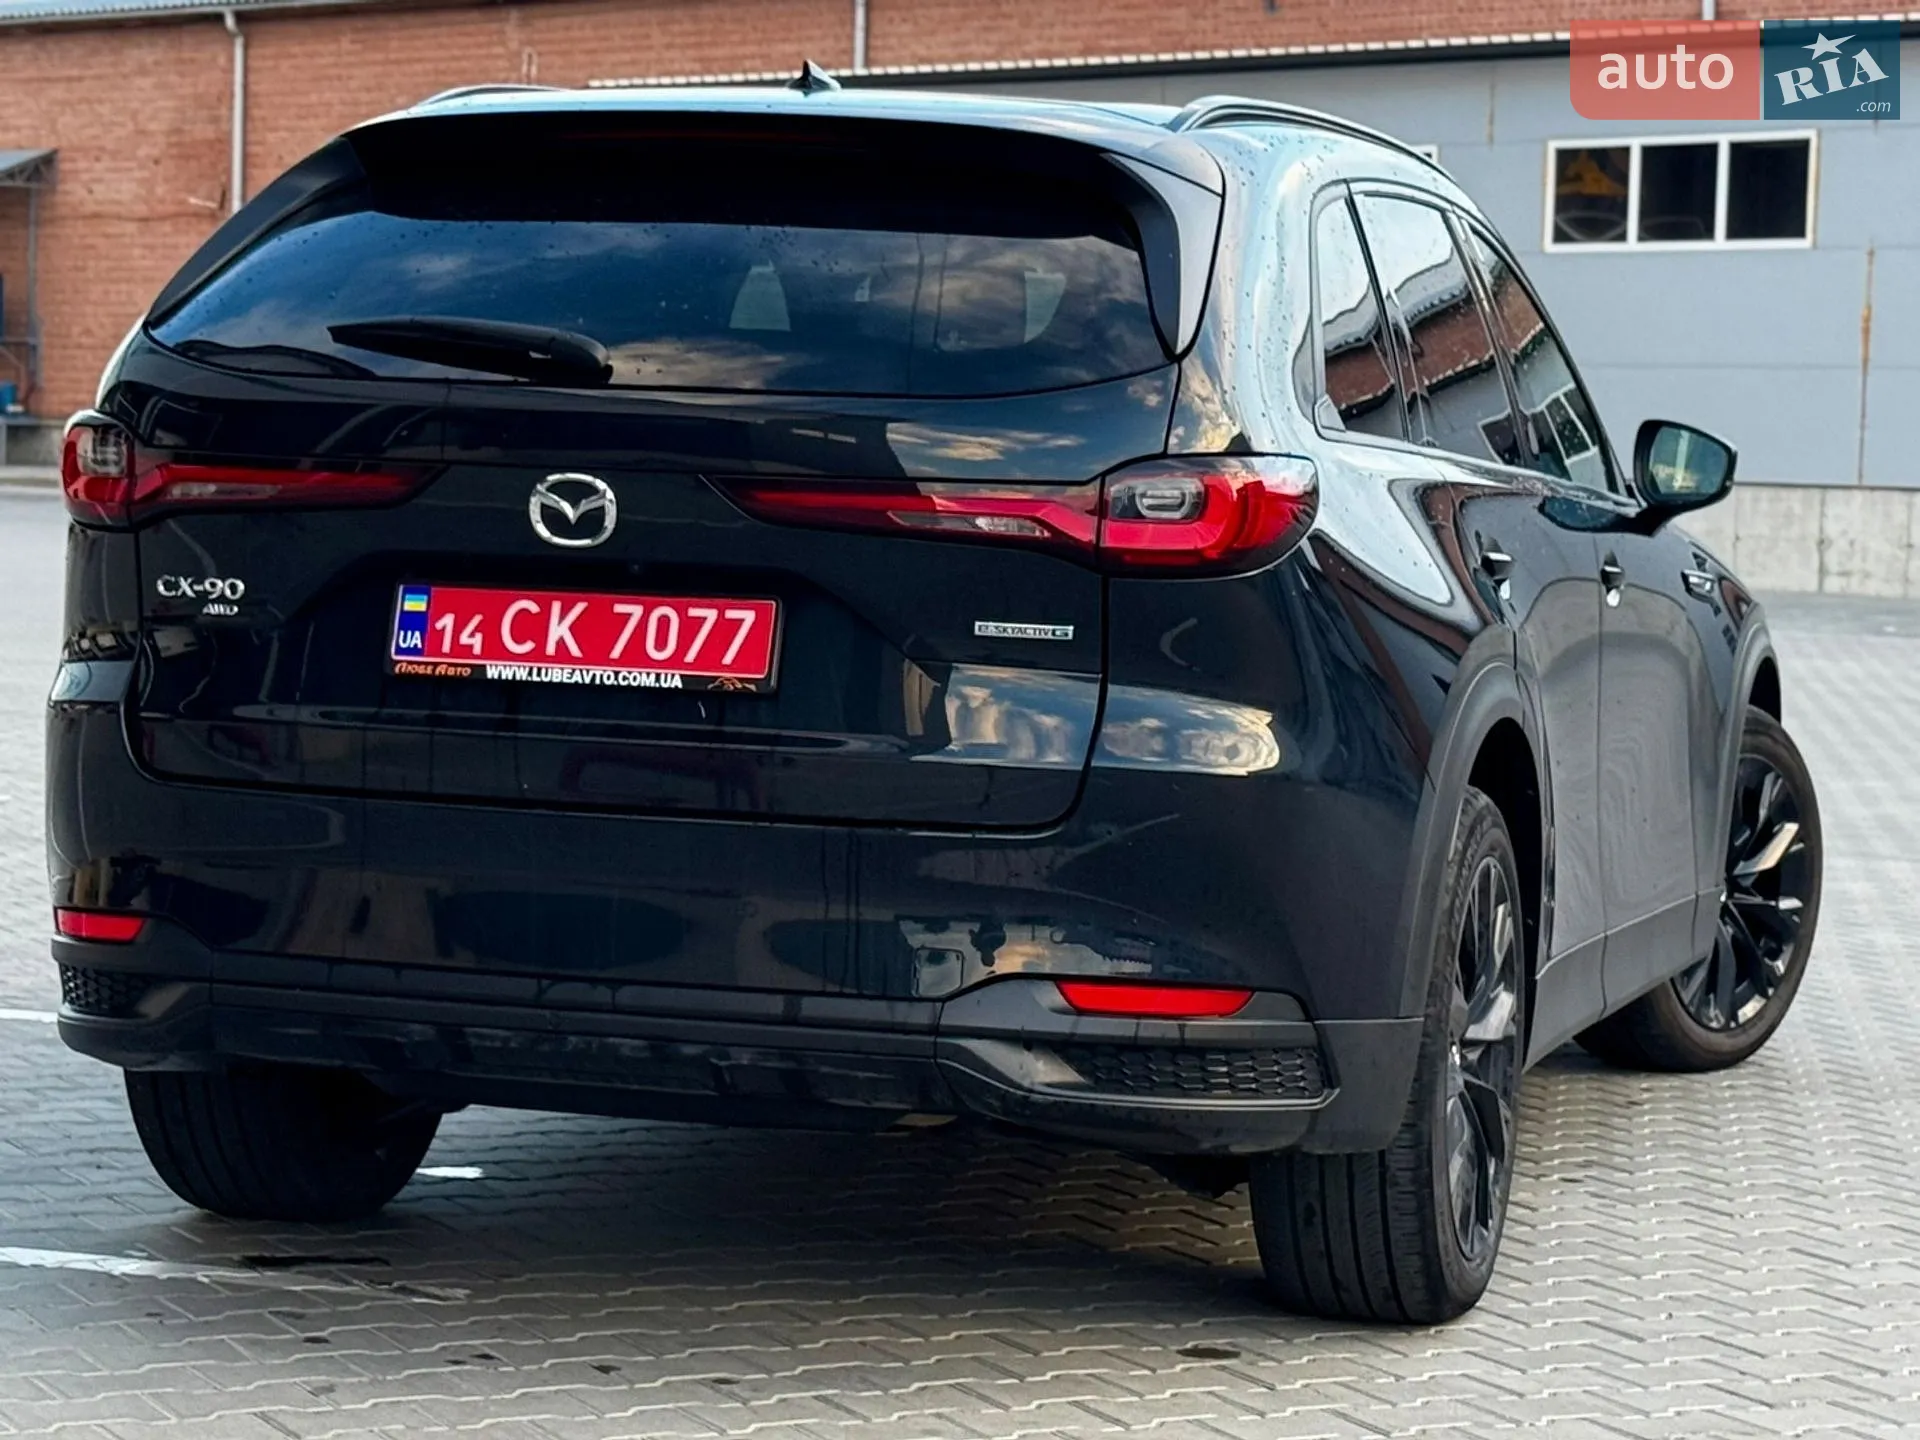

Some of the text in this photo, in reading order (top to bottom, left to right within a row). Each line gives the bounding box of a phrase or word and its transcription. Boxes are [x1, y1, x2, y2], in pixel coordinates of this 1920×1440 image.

[156, 574, 245, 600] CX-90
[202, 602, 239, 616] AWD
[399, 630, 422, 648] UA
[434, 599, 756, 666] 14 CK 7077
[485, 664, 684, 689] WWW.LUBEAVTO.COM.UA
